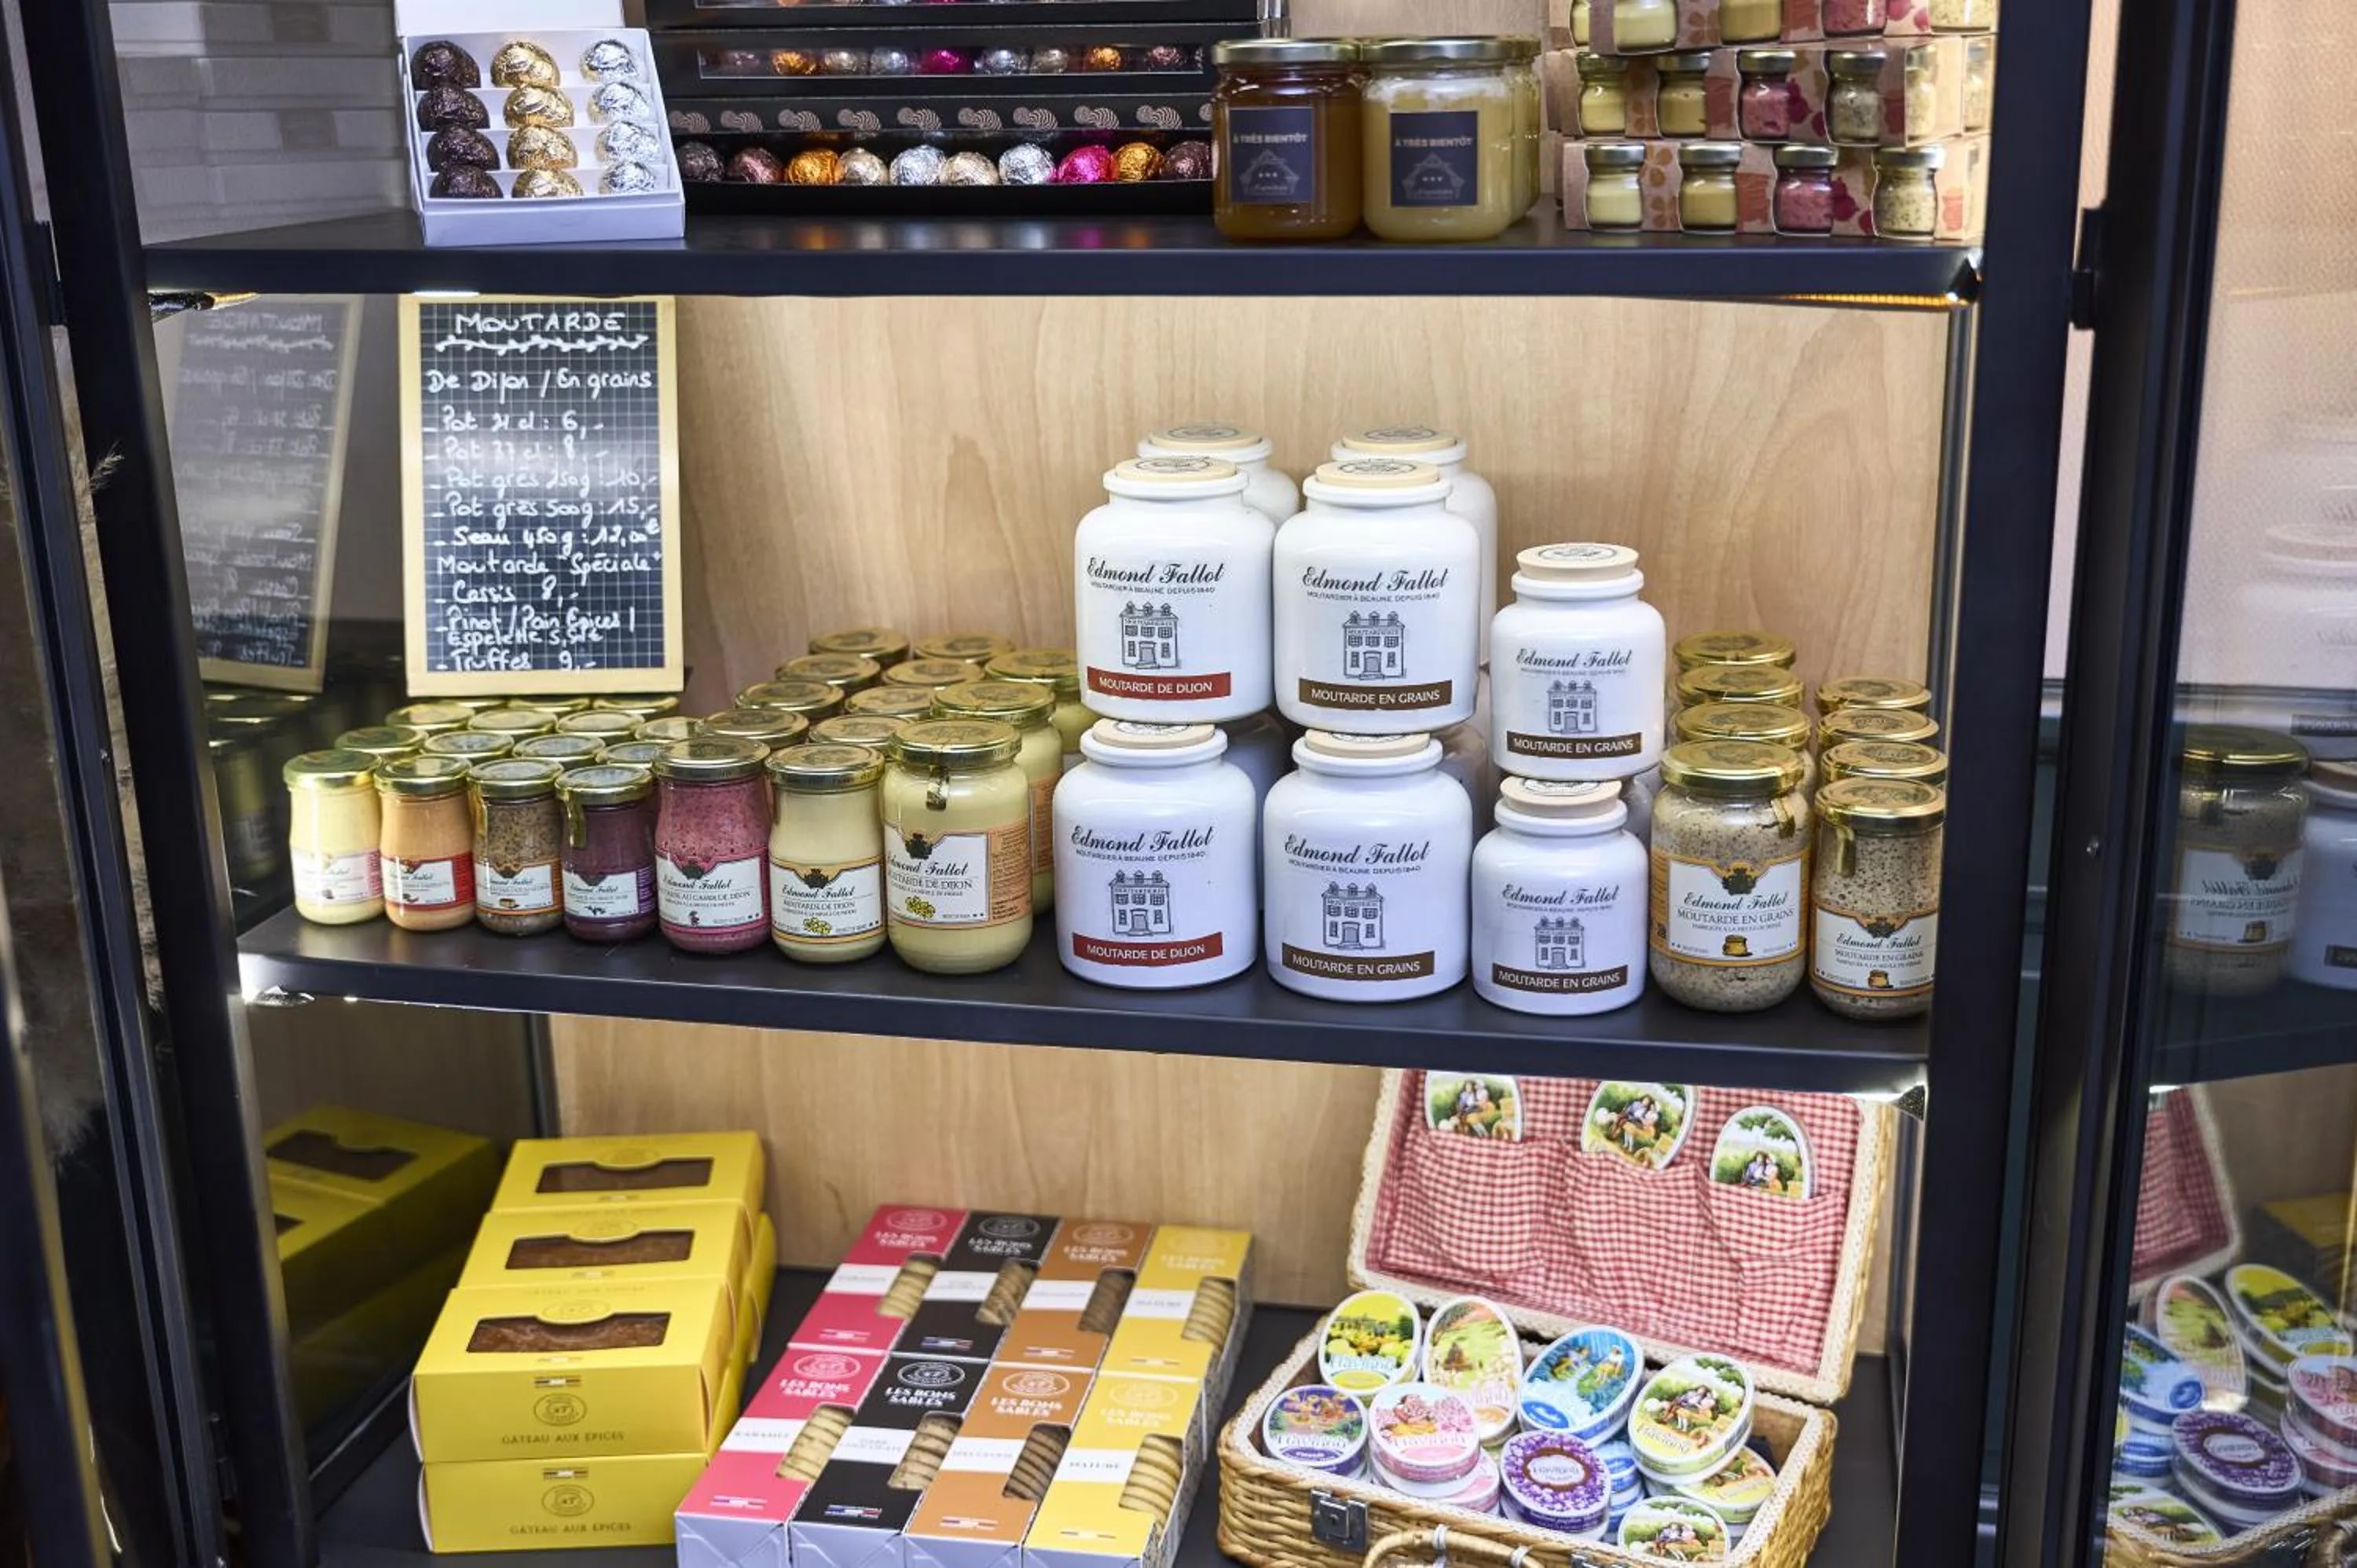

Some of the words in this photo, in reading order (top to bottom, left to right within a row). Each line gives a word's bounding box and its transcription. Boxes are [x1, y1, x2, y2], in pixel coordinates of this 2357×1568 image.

[455, 312, 626, 335] MOUTARDE
[425, 369, 460, 393] De
[471, 370, 529, 405] Dijon
[555, 367, 581, 388] En
[587, 371, 653, 401] grains
[442, 405, 478, 431] Pot
[444, 435, 482, 460] Pot
[444, 467, 484, 488] Pot
[445, 491, 484, 517] Pot
[453, 526, 511, 546] Seau
[436, 549, 550, 574] Moutarde
[1087, 557, 1156, 584] Edmond
[1159, 562, 1226, 584] Fallot
[1302, 566, 1384, 592] Edmond
[1387, 568, 1450, 592] Fallot
[452, 579, 517, 603] Cassis
[1395, 593, 1422, 603] DEPUIS
[446, 604, 503, 630] Pinot
[521, 604, 560, 630] Pain
[450, 647, 532, 672] Truffes
[1516, 648, 1579, 669] Edmond
[1583, 649, 1633, 669] Fallot
[1099, 676, 1154, 694] MOUTARDE
[1157, 683, 1173, 694] DE
[1176, 682, 1212, 694] DIJON
[1311, 688, 1375, 705] MOUTARDE
[1379, 694, 1396, 705] EN
[1398, 689, 1440, 704] GRAINS
[1514, 738, 1572, 753] MOUTARDE
[1575, 741, 1591, 753] EN
[1594, 738, 1633, 752] GRAINS
[1071, 825, 1146, 852] Edmond
[1149, 826, 1214, 852] Fallot
[1285, 833, 1362, 863] Edmond
[1365, 841, 1431, 864] Fallot
[925, 862, 969, 876] Fallot
[698, 879, 732, 890] Fallot
[822, 886, 856, 899] Fallot
[926, 879, 939, 889] DE
[940, 878, 973, 889] DIJON
[1501, 883, 1567, 904] Edmond
[1571, 885, 1620, 904] Fallot
[1684, 892, 1743, 910] Edmond
[1747, 890, 1788, 910] Fallot
[1677, 908, 1739, 925] MOUTARDE
[1742, 914, 1758, 925] EN
[1759, 907, 1794, 924] GRAINS
[1836, 932, 1883, 949] Edmond
[1886, 935, 1922, 949] Fallot
[1086, 943, 1147, 959] MOUTARDE
[1151, 950, 1167, 959] DE
[1170, 944, 1205, 958] DIJON
[1292, 954, 1354, 973] MOUTARDE
[1358, 965, 1373, 975] EN
[1376, 961, 1420, 975] GRAINS
[1498, 970, 1560, 987] MOUTARDE
[1563, 976, 1578, 987] EN
[1582, 972, 1622, 987] GRAINS
[779, 1379, 806, 1390] LES
[808, 1380, 852, 1392] BONS
[885, 1387, 913, 1397] LES
[918, 1389, 956, 1400] BONS
[990, 1397, 1018, 1406] LES
[1021, 1398, 1063, 1410] BONS
[555, 1433, 580, 1443] AUX
[563, 1523, 587, 1533] AUX
